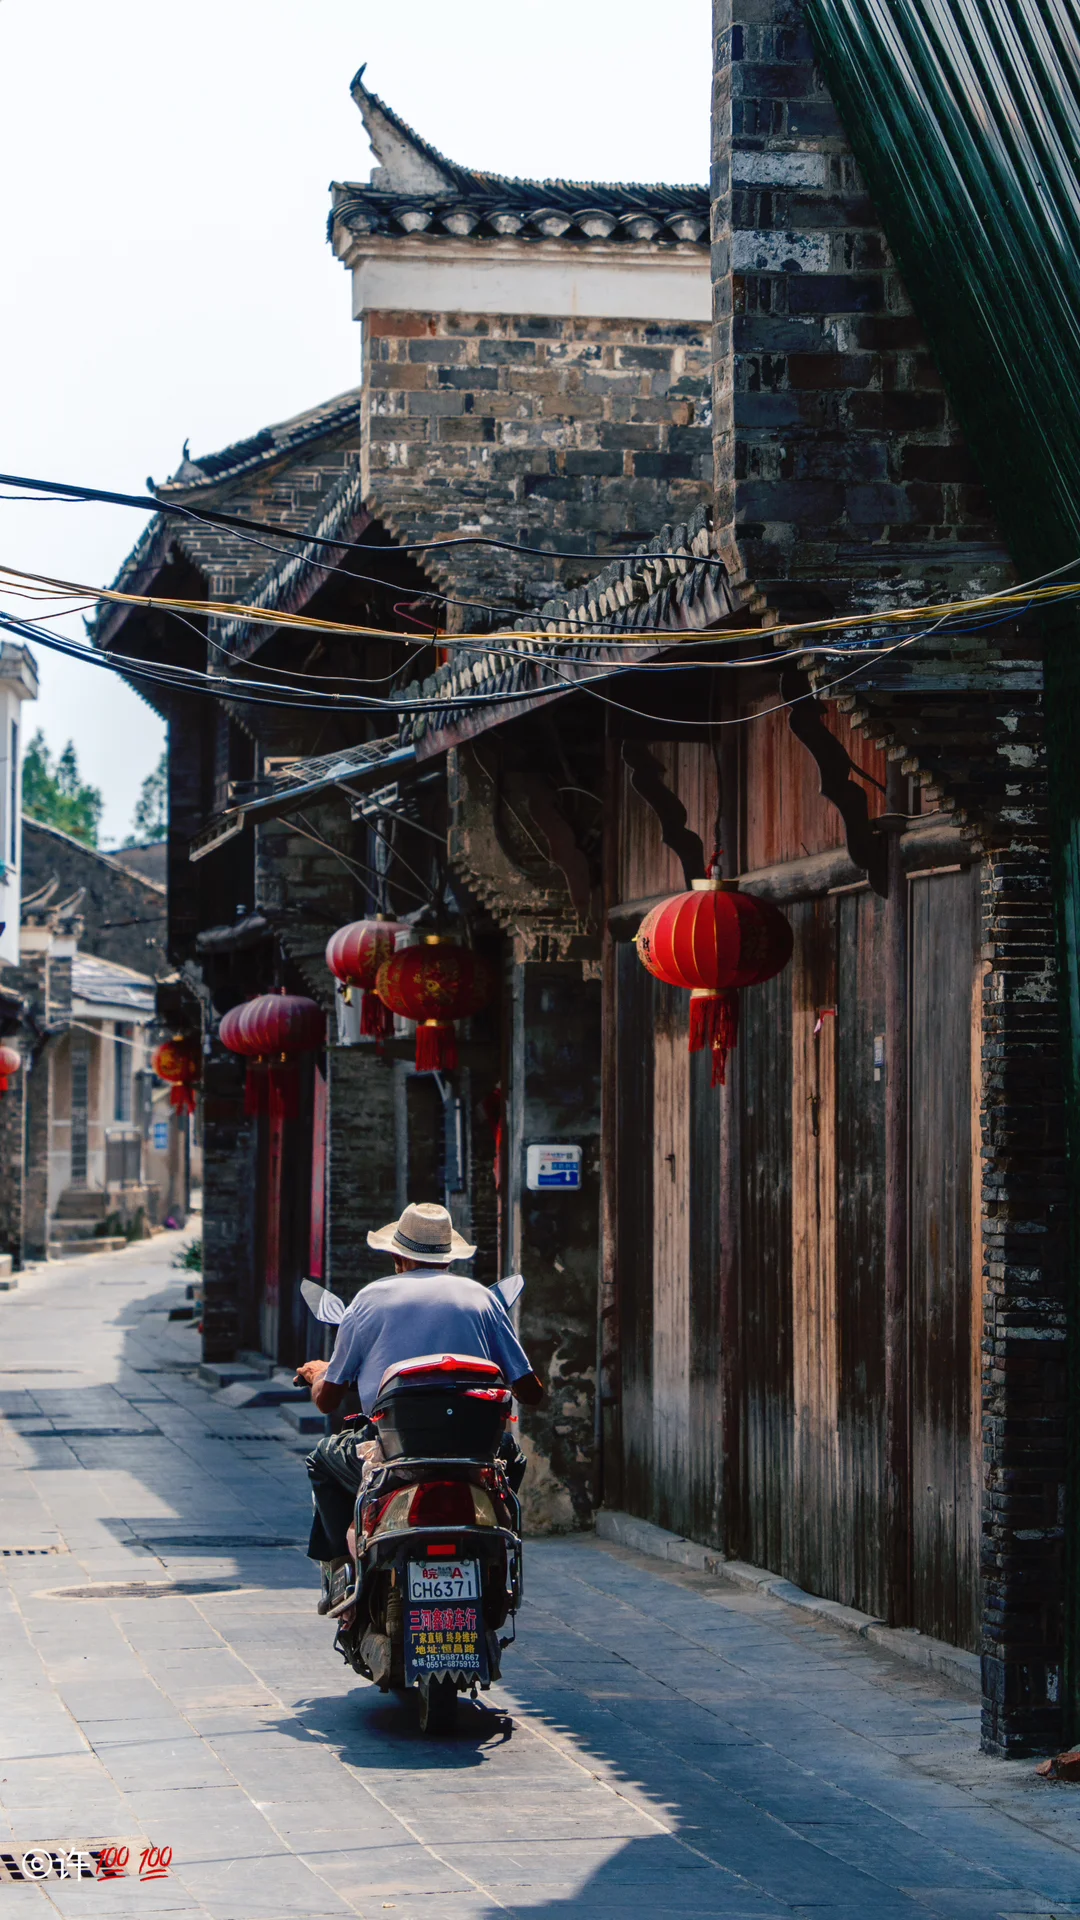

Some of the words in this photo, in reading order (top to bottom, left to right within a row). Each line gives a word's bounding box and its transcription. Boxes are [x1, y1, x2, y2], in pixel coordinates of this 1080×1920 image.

[423, 1568, 438, 1579] 皖
[451, 1567, 463, 1579] A
[412, 1581, 472, 1598] CH6371
[411, 1632, 443, 1644] 厂家直销
[446, 1631, 478, 1644] 终身维护
[426, 1661, 480, 1669] 0551-68759123
